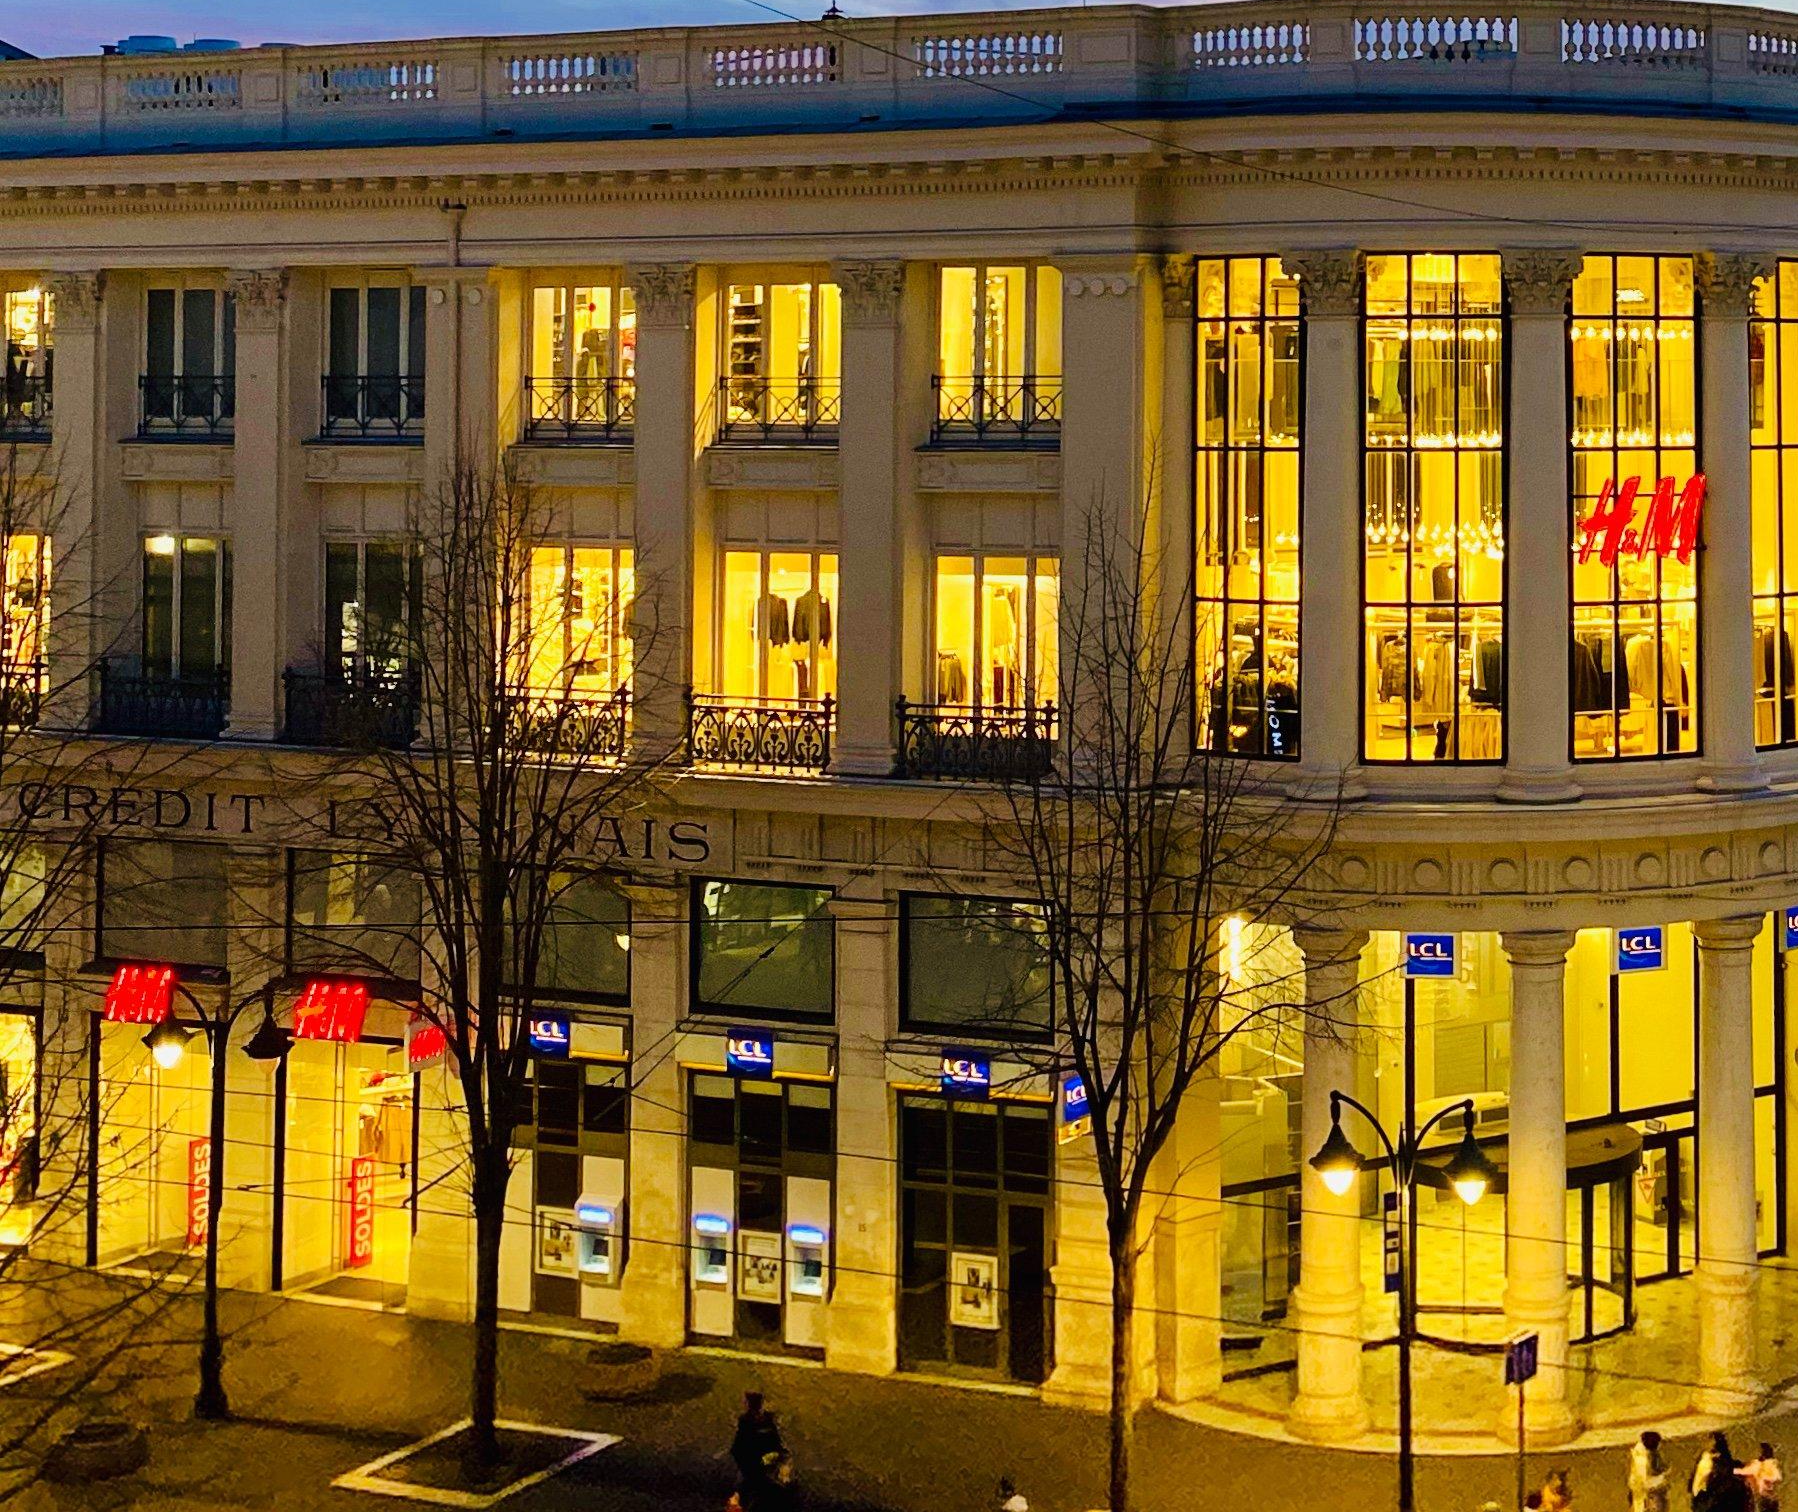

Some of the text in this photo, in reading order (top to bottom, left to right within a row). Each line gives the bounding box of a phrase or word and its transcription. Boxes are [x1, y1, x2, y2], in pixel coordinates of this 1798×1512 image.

[1577, 473, 1706, 568] H&M
[18, 782, 711, 864] CREDIT LYNAIS
[1410, 942, 1447, 957] LCL
[1621, 936, 1654, 952] LCL
[530, 1020, 565, 1038] LCL
[729, 1039, 767, 1058] LCL
[943, 1058, 984, 1078] LCL
[192, 1143, 211, 1237] SOLDES
[355, 1160, 373, 1258] SOLDES
